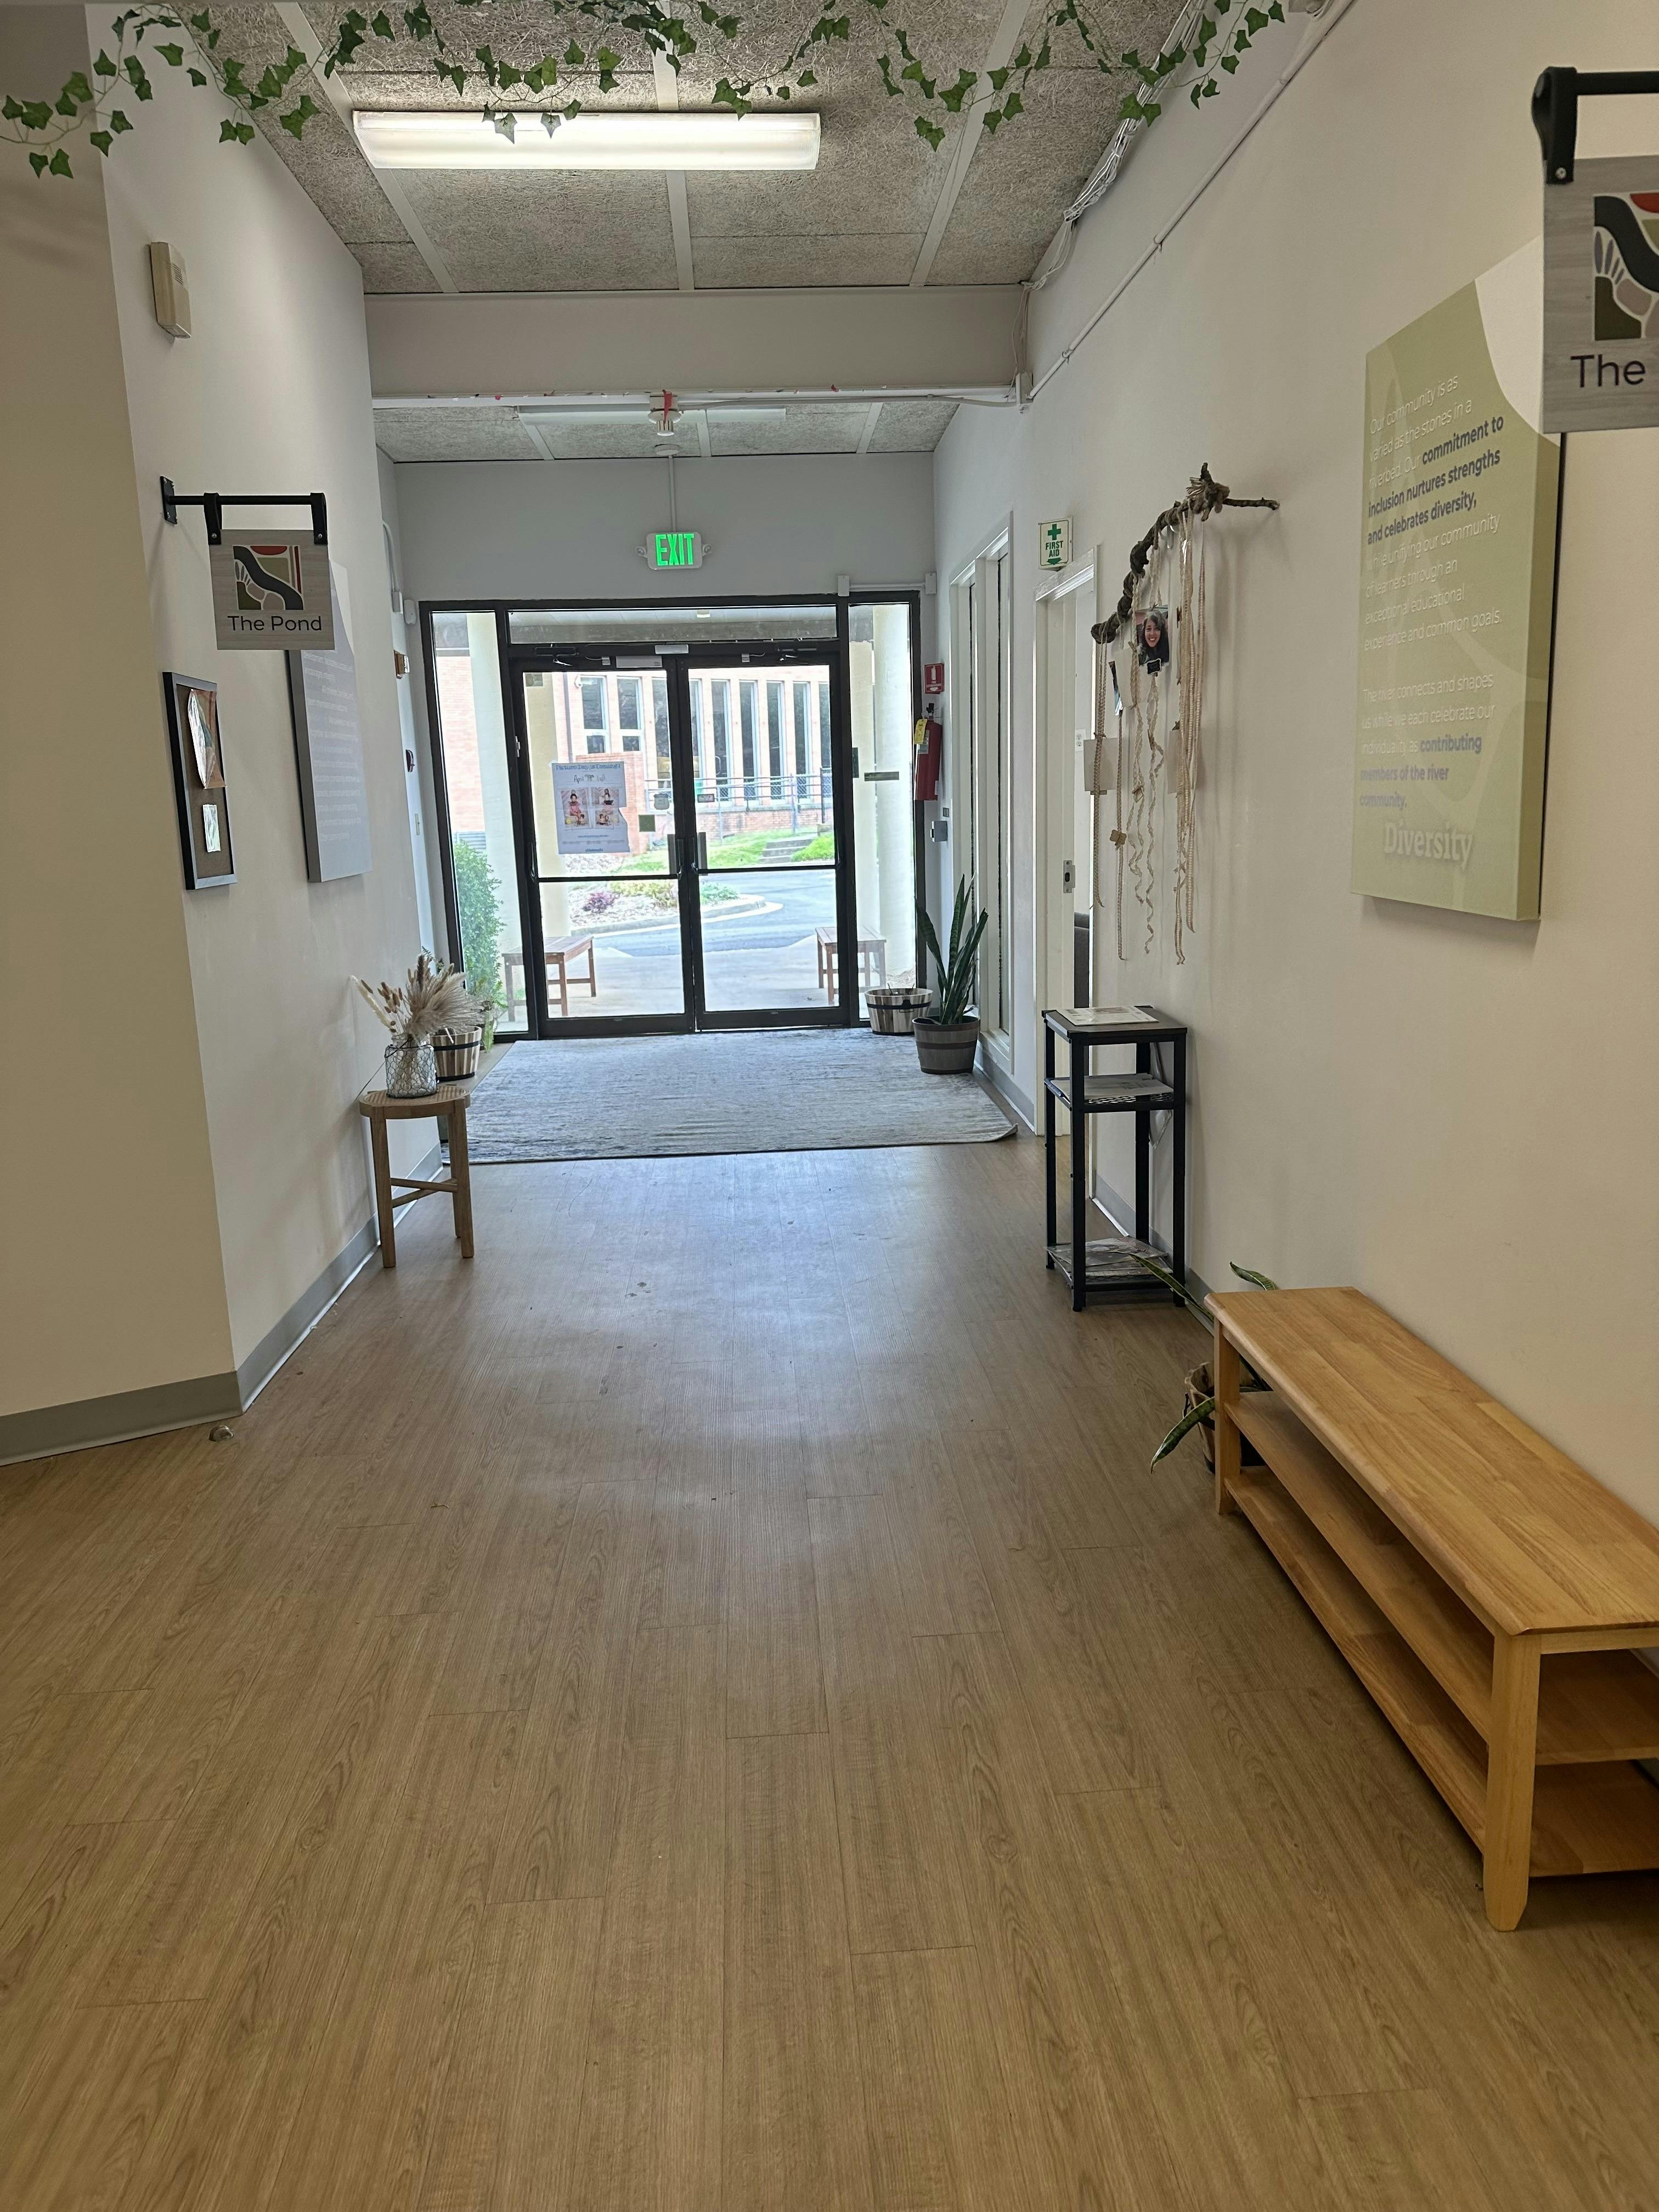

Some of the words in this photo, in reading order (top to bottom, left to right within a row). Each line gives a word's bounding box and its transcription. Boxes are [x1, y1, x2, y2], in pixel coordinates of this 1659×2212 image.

[1571, 354, 1645, 387] The
[1370, 417, 1386, 435] Our
[1386, 387, 1436, 426] community
[1438, 381, 1445, 397] is
[1447, 375, 1458, 393] as
[1370, 440, 1394, 462] varied
[1395, 436, 1404, 450] as
[1404, 426, 1420, 445] the
[1421, 410, 1452, 436] stones
[1454, 403, 1463, 419] in
[1465, 399, 1472, 413] a
[1404, 454, 1421, 473] Our
[1422, 420, 1488, 465] commitment
[1492, 416, 1504, 433] to
[1368, 491, 1404, 518] inclusion
[1406, 473, 1446, 501] nurtures
[1448, 448, 1500, 477] strengths
[1368, 524, 1383, 545] and
[1384, 509, 1429, 538] celebrates
[1431, 490, 1477, 520] diversity,
[656, 533, 694, 566] EXIT
[1046, 540, 1063, 550] FIRST
[1049, 549, 1059, 557] AID
[1389, 540, 1422, 563] unifying
[1424, 535, 1439, 551] our
[1441, 513, 1500, 546] community
[1365, 583, 1376, 598] of
[1407, 563, 1444, 586] through
[1446, 559, 1458, 574] an
[1411, 583, 1465, 613] educational
[227, 616, 264, 631] The
[271, 616, 321, 631] Pond
[1408, 623, 1425, 642] and
[1426, 617, 1470, 637] common
[1471, 606, 1502, 633] goals.
[1362, 689, 1377, 703] The
[1397, 682, 1436, 699] connects
[1436, 678, 1454, 694] and
[1457, 674, 1494, 693] shapes
[1407, 710, 1429, 725] each
[1430, 705, 1476, 724] celebrate
[1478, 704, 1497, 719] our
[1408, 740, 1419, 753] as
[1420, 733, 1482, 754] contributing
[1360, 766, 1398, 781] members
[1399, 765, 1409, 781] of
[1410, 765, 1425, 781] the
[1427, 763, 1449, 781] river
[1359, 791, 1407, 811] community.
[1384, 818, 1475, 872] Diversity
